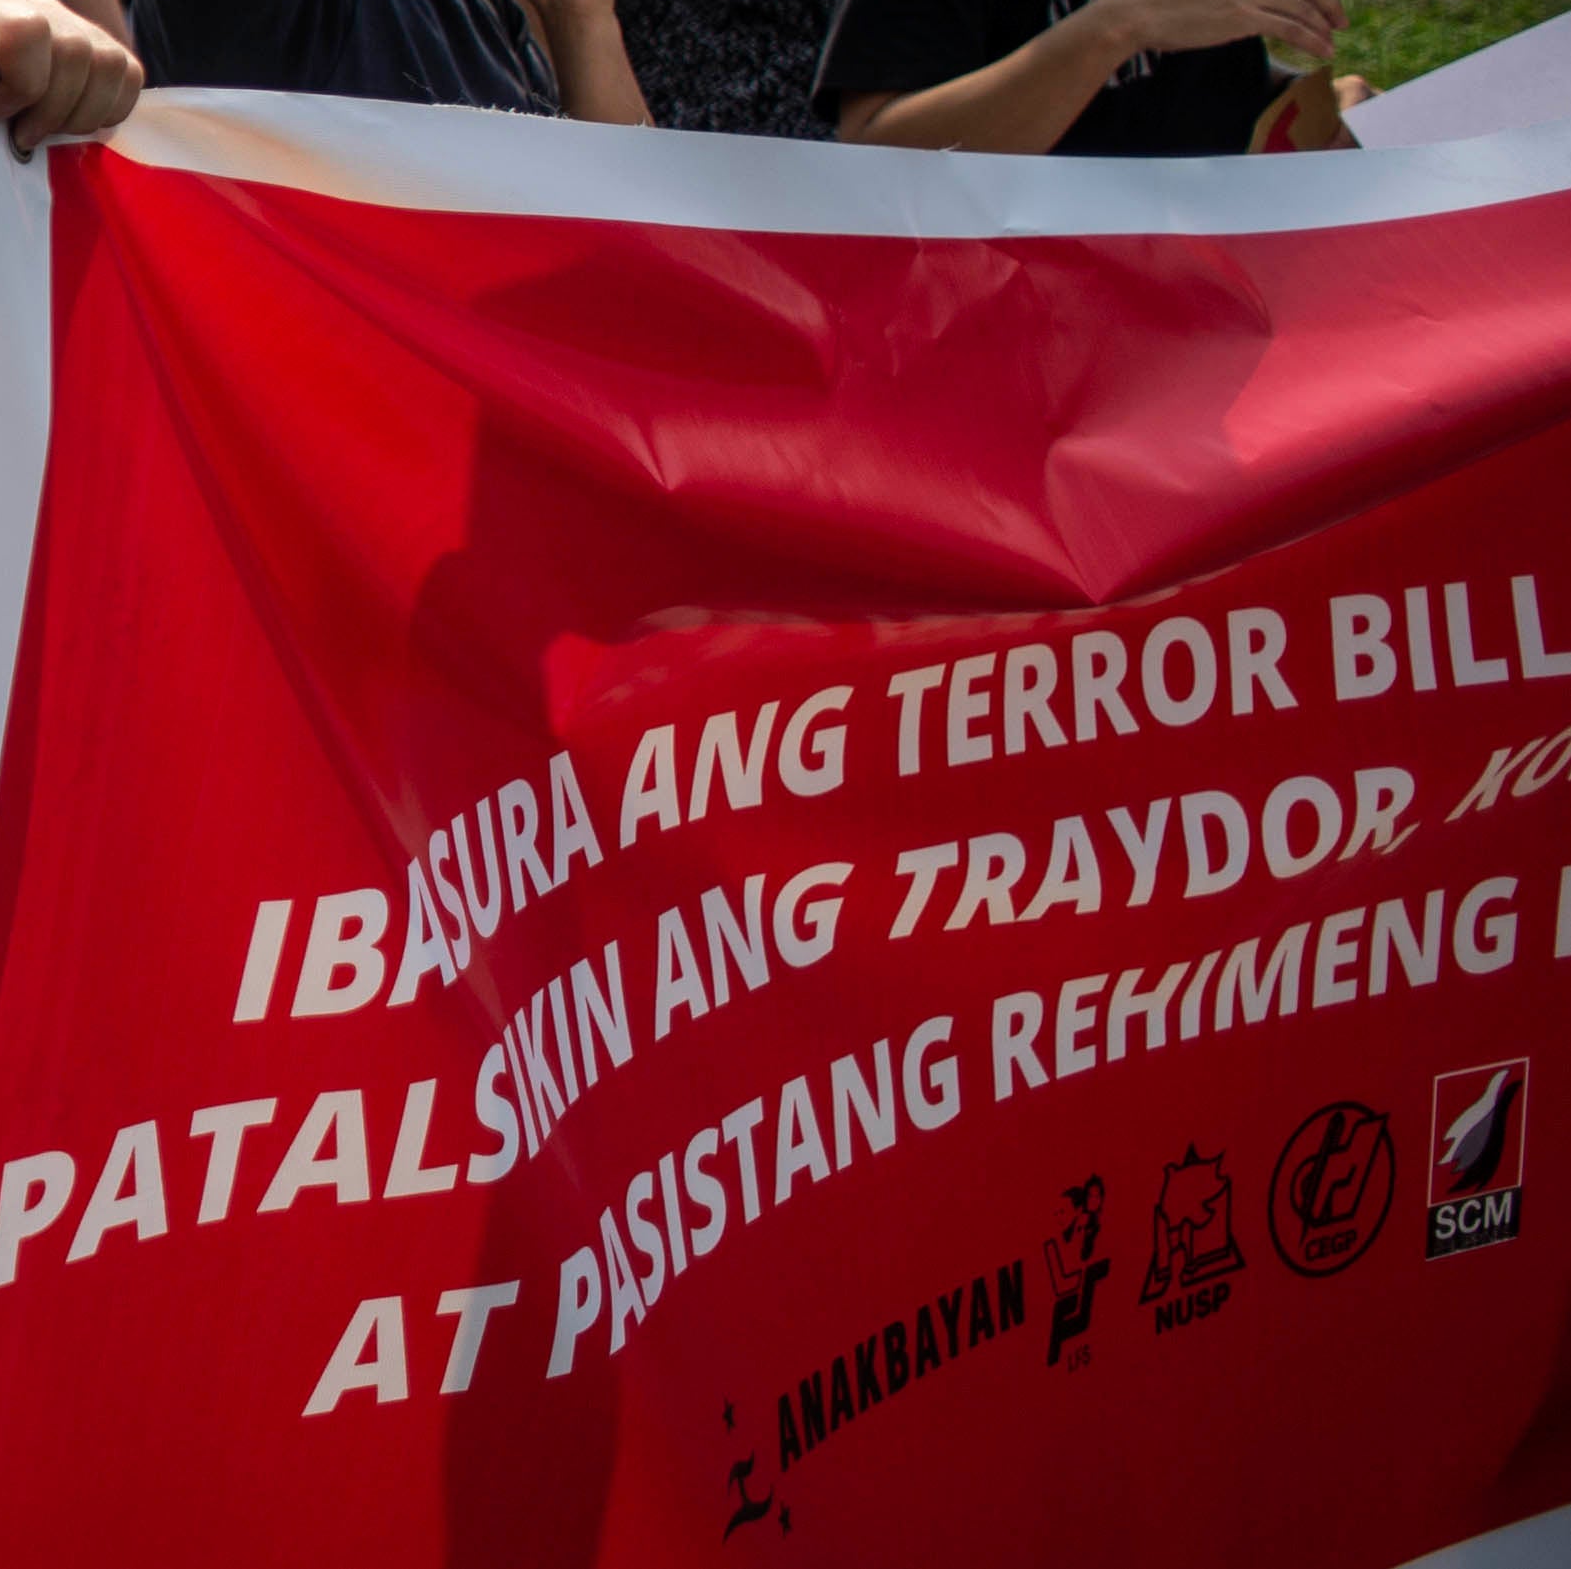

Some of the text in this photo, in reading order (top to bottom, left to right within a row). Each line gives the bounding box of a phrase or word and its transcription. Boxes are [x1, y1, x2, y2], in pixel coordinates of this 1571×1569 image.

[231, 571, 1571, 1027] IBASURA ANG TERROR BILL
[655, 860, 855, 1045] ANG
[886, 763, 1422, 942] TRAYDOR,
[300, 1278, 522, 1420] AT
[544, 1014, 963, 1381] PASISTANG
[990, 873, 1520, 1104] REHIMENG
[1434, 1189, 1513, 1242] SCM
[776, 1258, 1030, 1473] ANAKBAYAN
[1154, 1281, 1232, 1336] NUSP
